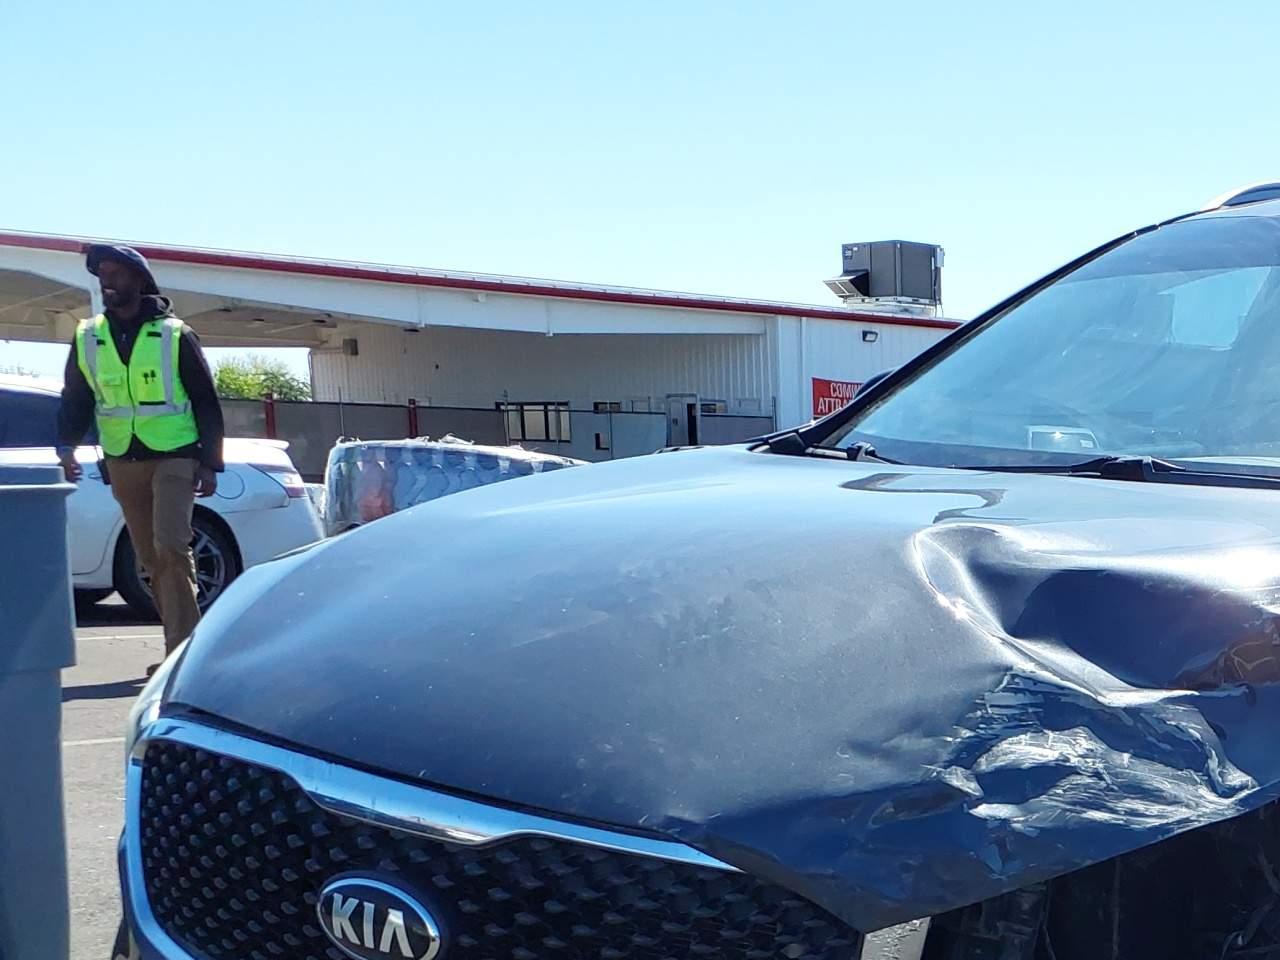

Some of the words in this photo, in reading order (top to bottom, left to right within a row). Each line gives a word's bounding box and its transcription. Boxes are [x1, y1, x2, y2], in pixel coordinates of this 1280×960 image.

[830, 382, 862, 399] COMIN
[817, 397, 850, 413] ATTRA
[332, 892, 415, 959] KIA
